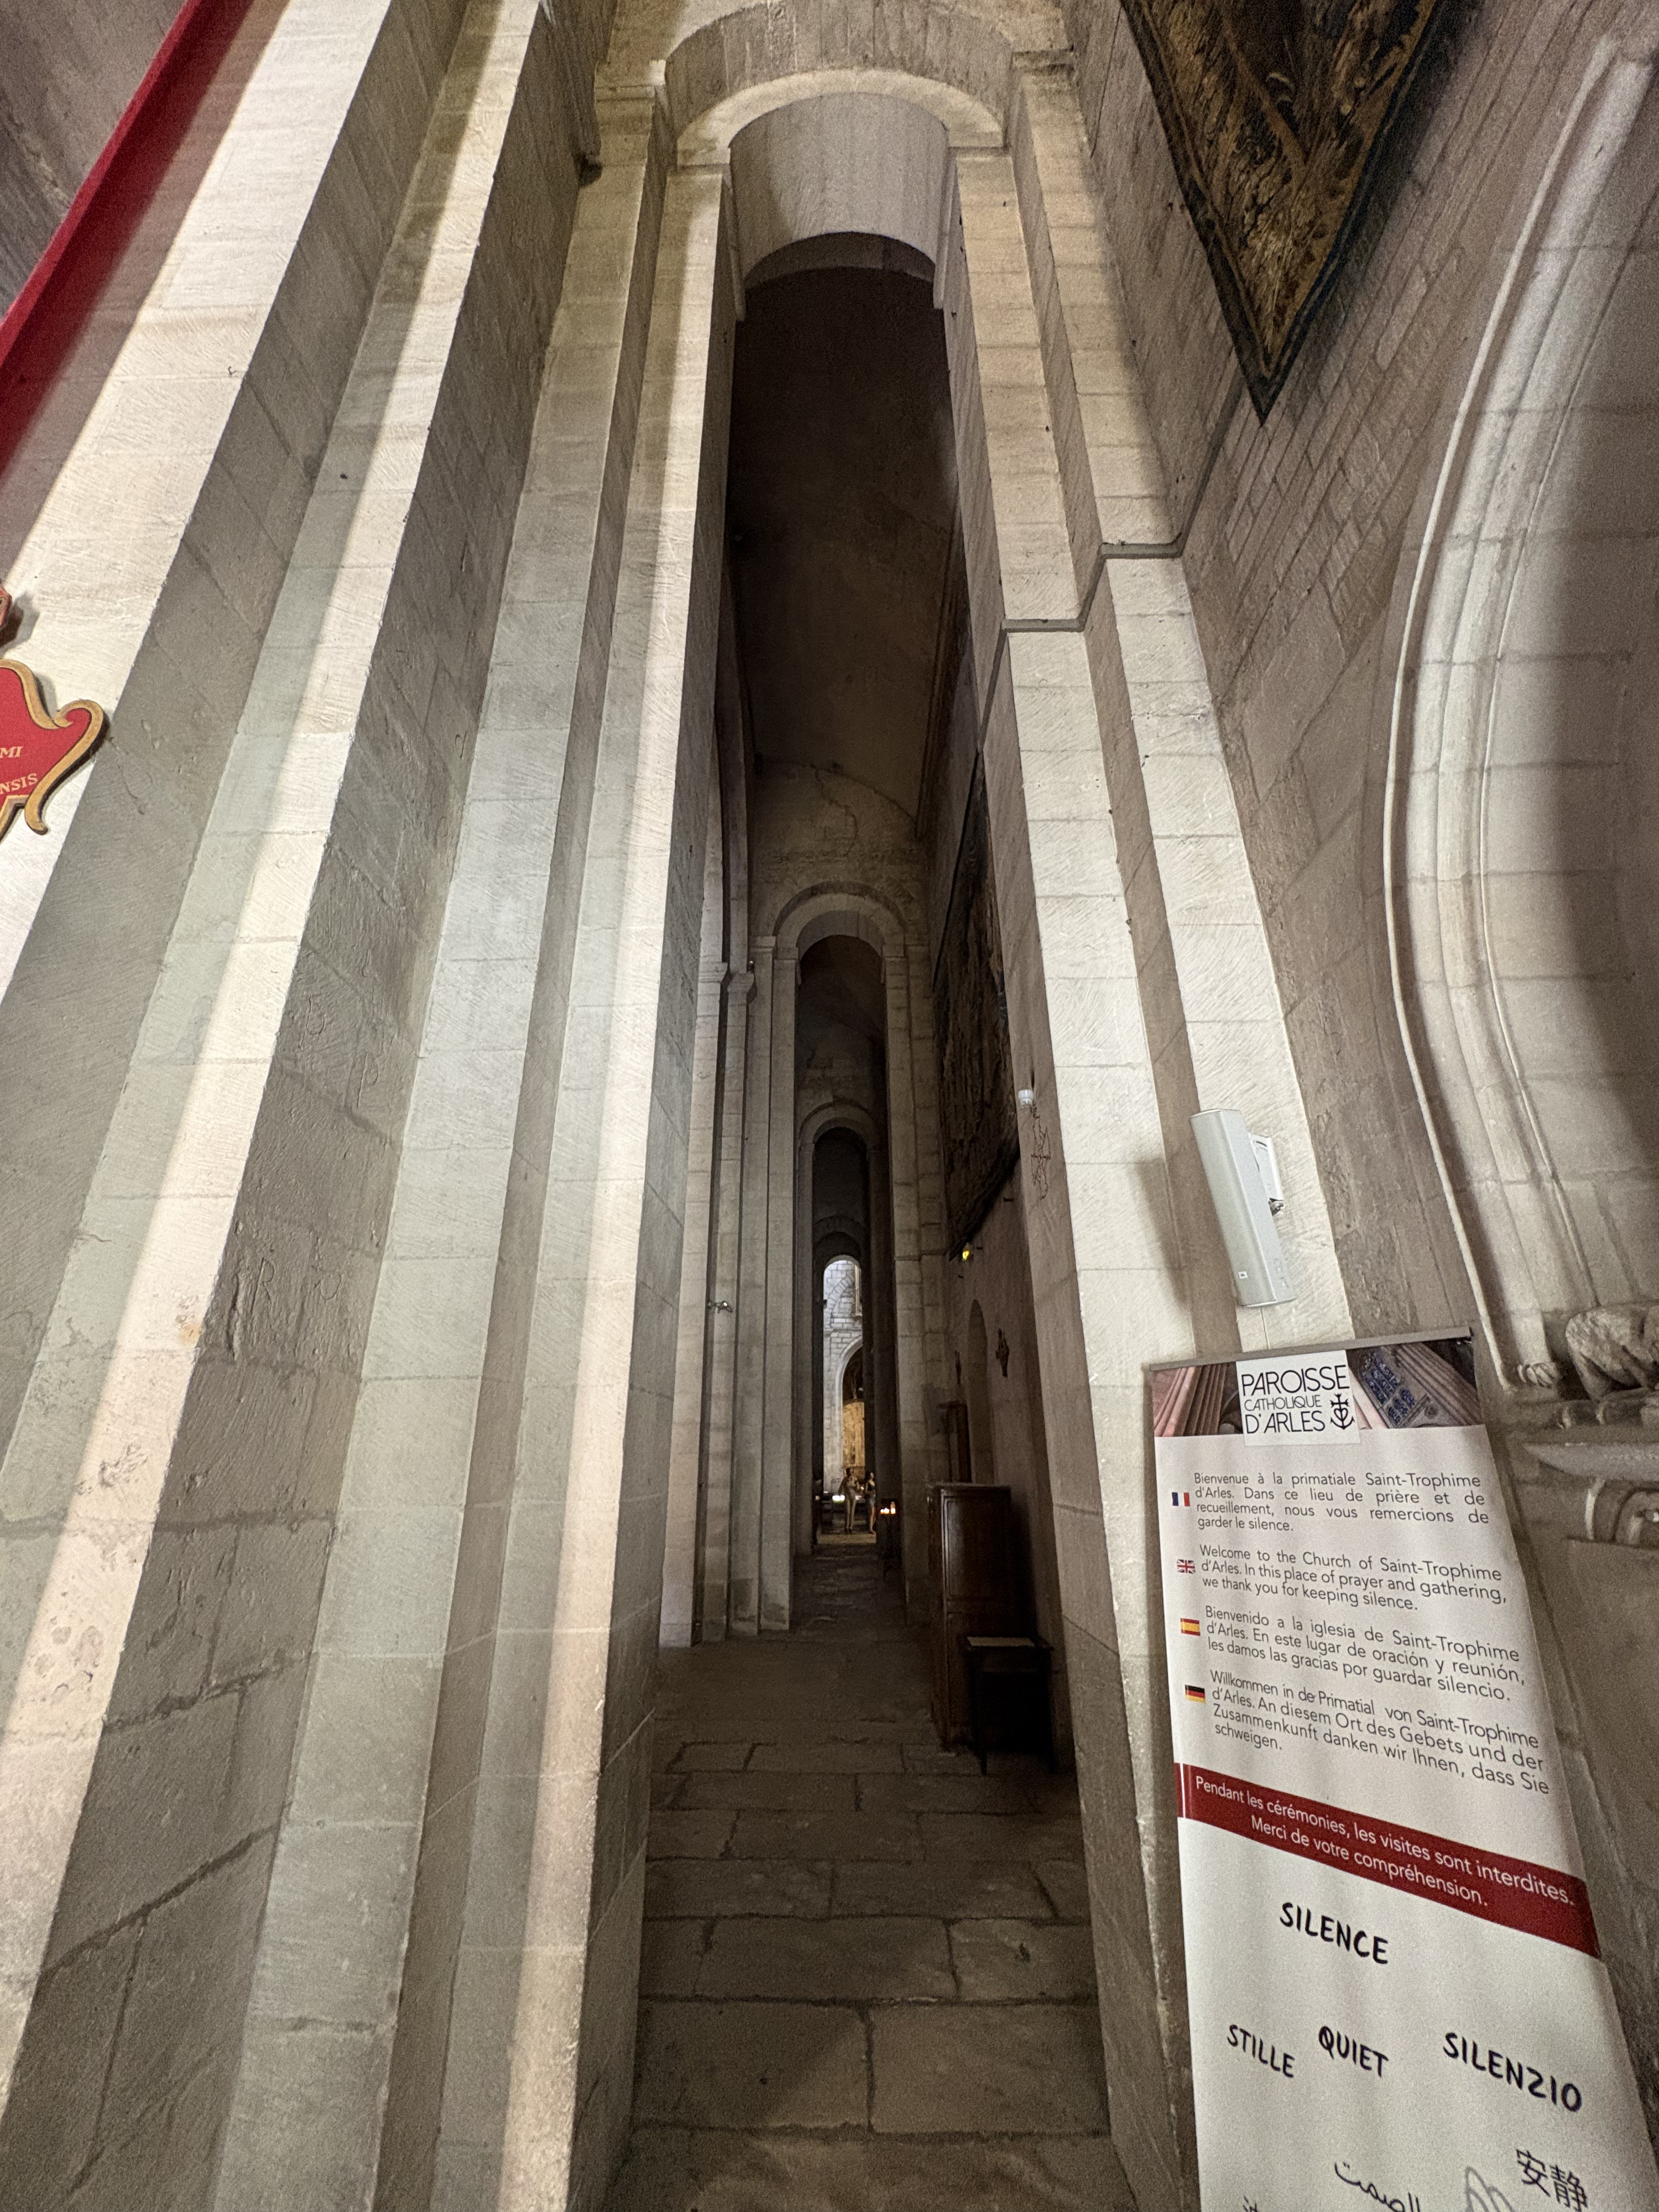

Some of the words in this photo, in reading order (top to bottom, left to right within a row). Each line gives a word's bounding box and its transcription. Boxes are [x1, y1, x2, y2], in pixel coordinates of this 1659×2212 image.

[1241, 1365, 1350, 1396] PAROISSE
[1244, 1395, 1322, 1411] CATHOLIQUE
[1245, 1411, 1325, 1434] D'ARLES
[1194, 1473, 1249, 1484] Bienvenue
[1258, 1473, 1265, 1484] à
[1273, 1472, 1283, 1484] la
[1292, 1473, 1356, 1488] primatiale
[1365, 1472, 1481, 1491] Saint-Trophime
[1195, 1486, 1235, 1499] d'Arles.
[1244, 1487, 1275, 1500] Dans
[1284, 1491, 1298, 1500] ce
[1310, 1488, 1334, 1501] lieu
[1345, 1489, 1363, 1502] de
[1376, 1489, 1420, 1506] prière
[1434, 1493, 1451, 1504] et
[1464, 1490, 1485, 1505] de
[1197, 1501, 1274, 1517] recueillement,
[1285, 1506, 1314, 1516] nous
[1326, 1507, 1358, 1519] vous
[1370, 1507, 1454, 1522] remercions
[1468, 1509, 1489, 1524] de
[1198, 1515, 1233, 1530] garder
[1235, 1516, 1245, 1529] le
[1249, 1517, 1293, 1531] silence.
[1199, 1544, 1251, 1560] Welcome
[1257, 1550, 1270, 1562] to
[1276, 1550, 1296, 1564] the
[1302, 1551, 1351, 1569] Church
[1359, 1556, 1373, 1570] of
[1380, 1557, 1501, 1582] Saint-Trophime
[1201, 1560, 1242, 1575] d'Arles.
[1245, 1563, 1255, 1576] In
[1259, 1564, 1281, 1578] this
[1284, 1566, 1317, 1583] place
[1321, 1570, 1335, 1584] of
[1339, 1574, 1383, 1590] prayer
[1387, 1577, 1415, 1592] and
[1420, 1580, 1506, 1604] gathering,
[1203, 1579, 1219, 1588] we
[1222, 1577, 1252, 1591] thank
[1255, 1583, 1278, 1597] you
[1282, 1582, 1299, 1597] for
[1302, 1584, 1359, 1608] keeping
[1363, 1591, 1418, 1611] silence.
[1206, 1605, 1269, 1626] Bienvenido
[1277, 1618, 1285, 1628] a
[1292, 1615, 1303, 1631] la
[1311, 1619, 1355, 1639] iglesia
[1364, 1626, 1384, 1642] de
[1392, 1630, 1520, 1662] Saint-Trophime
[1207, 1621, 1248, 1640] d'Arles.
[1254, 1628, 1269, 1643] En
[1275, 1634, 1302, 1648] este
[1306, 1636, 1341, 1656] lugar
[1347, 1642, 1366, 1658] de
[1372, 1650, 1429, 1668] oración
[1435, 1659, 1444, 1674] y
[1452, 1661, 1525, 1686] reunión,
[1208, 1637, 1224, 1652] les
[1227, 1641, 1266, 1659] damos
[1270, 1646, 1287, 1663] las
[1291, 1654, 1338, 1671] gracias
[1343, 1663, 1368, 1678] por
[1373, 1669, 1432, 1688] guardar
[1438, 1676, 1510, 1701] silencio.
[1209, 1669, 1278, 1696] Willkommen
[1282, 1683, 1294, 1698] in
[1318, 1691, 1375, 1715] Primatial
[1385, 1707, 1412, 1723] von
[1416, 1709, 1539, 1749] Saint-Trophime
[1212, 1688, 1255, 1708] d'Arles.
[1258, 1697, 1276, 1713] An
[1281, 1701, 1331, 1725] diesem
[1335, 1713, 1363, 1733] Ort
[1366, 1719, 1396, 1739] des
[1400, 1726, 1463, 1754] Gebets
[1469, 1745, 1506, 1763] und
[1512, 1750, 1543, 1771] der
[1213, 1703, 1319, 1741] Zusammenkunft
[1323, 1730, 1379, 1755] danken
[1383, 1744, 1407, 1761] wir
[1413, 1747, 1465, 1778] Ihnen,
[1472, 1762, 1515, 1786] dass
[1521, 1772, 1549, 1794] Sie
[1214, 1723, 1283, 1750] schweigen.
[1196, 1776, 1245, 1803] Pendant
[1246, 1790, 1264, 1809] les
[1267, 1800, 1350, 1839] cérémonies,
[1354, 1822, 1376, 1844] les
[1380, 1833, 1431, 1860] visites
[1434, 1851, 1472, 1875] sont
[1476, 1860, 1574, 1906] interdites.
[1251, 1815, 1287, 1840] Merci
[1291, 1828, 1310, 1847] de
[1312, 1838, 1349, 1860] votre
[1354, 1852, 1488, 1906] compréhension.
[1280, 1902, 1388, 1964] SILENCE
[1227, 2024, 1295, 2078] STILLE
[1318, 2026, 1389, 2078] QUIET
[1443, 2032, 1582, 2112] SILENZIO
